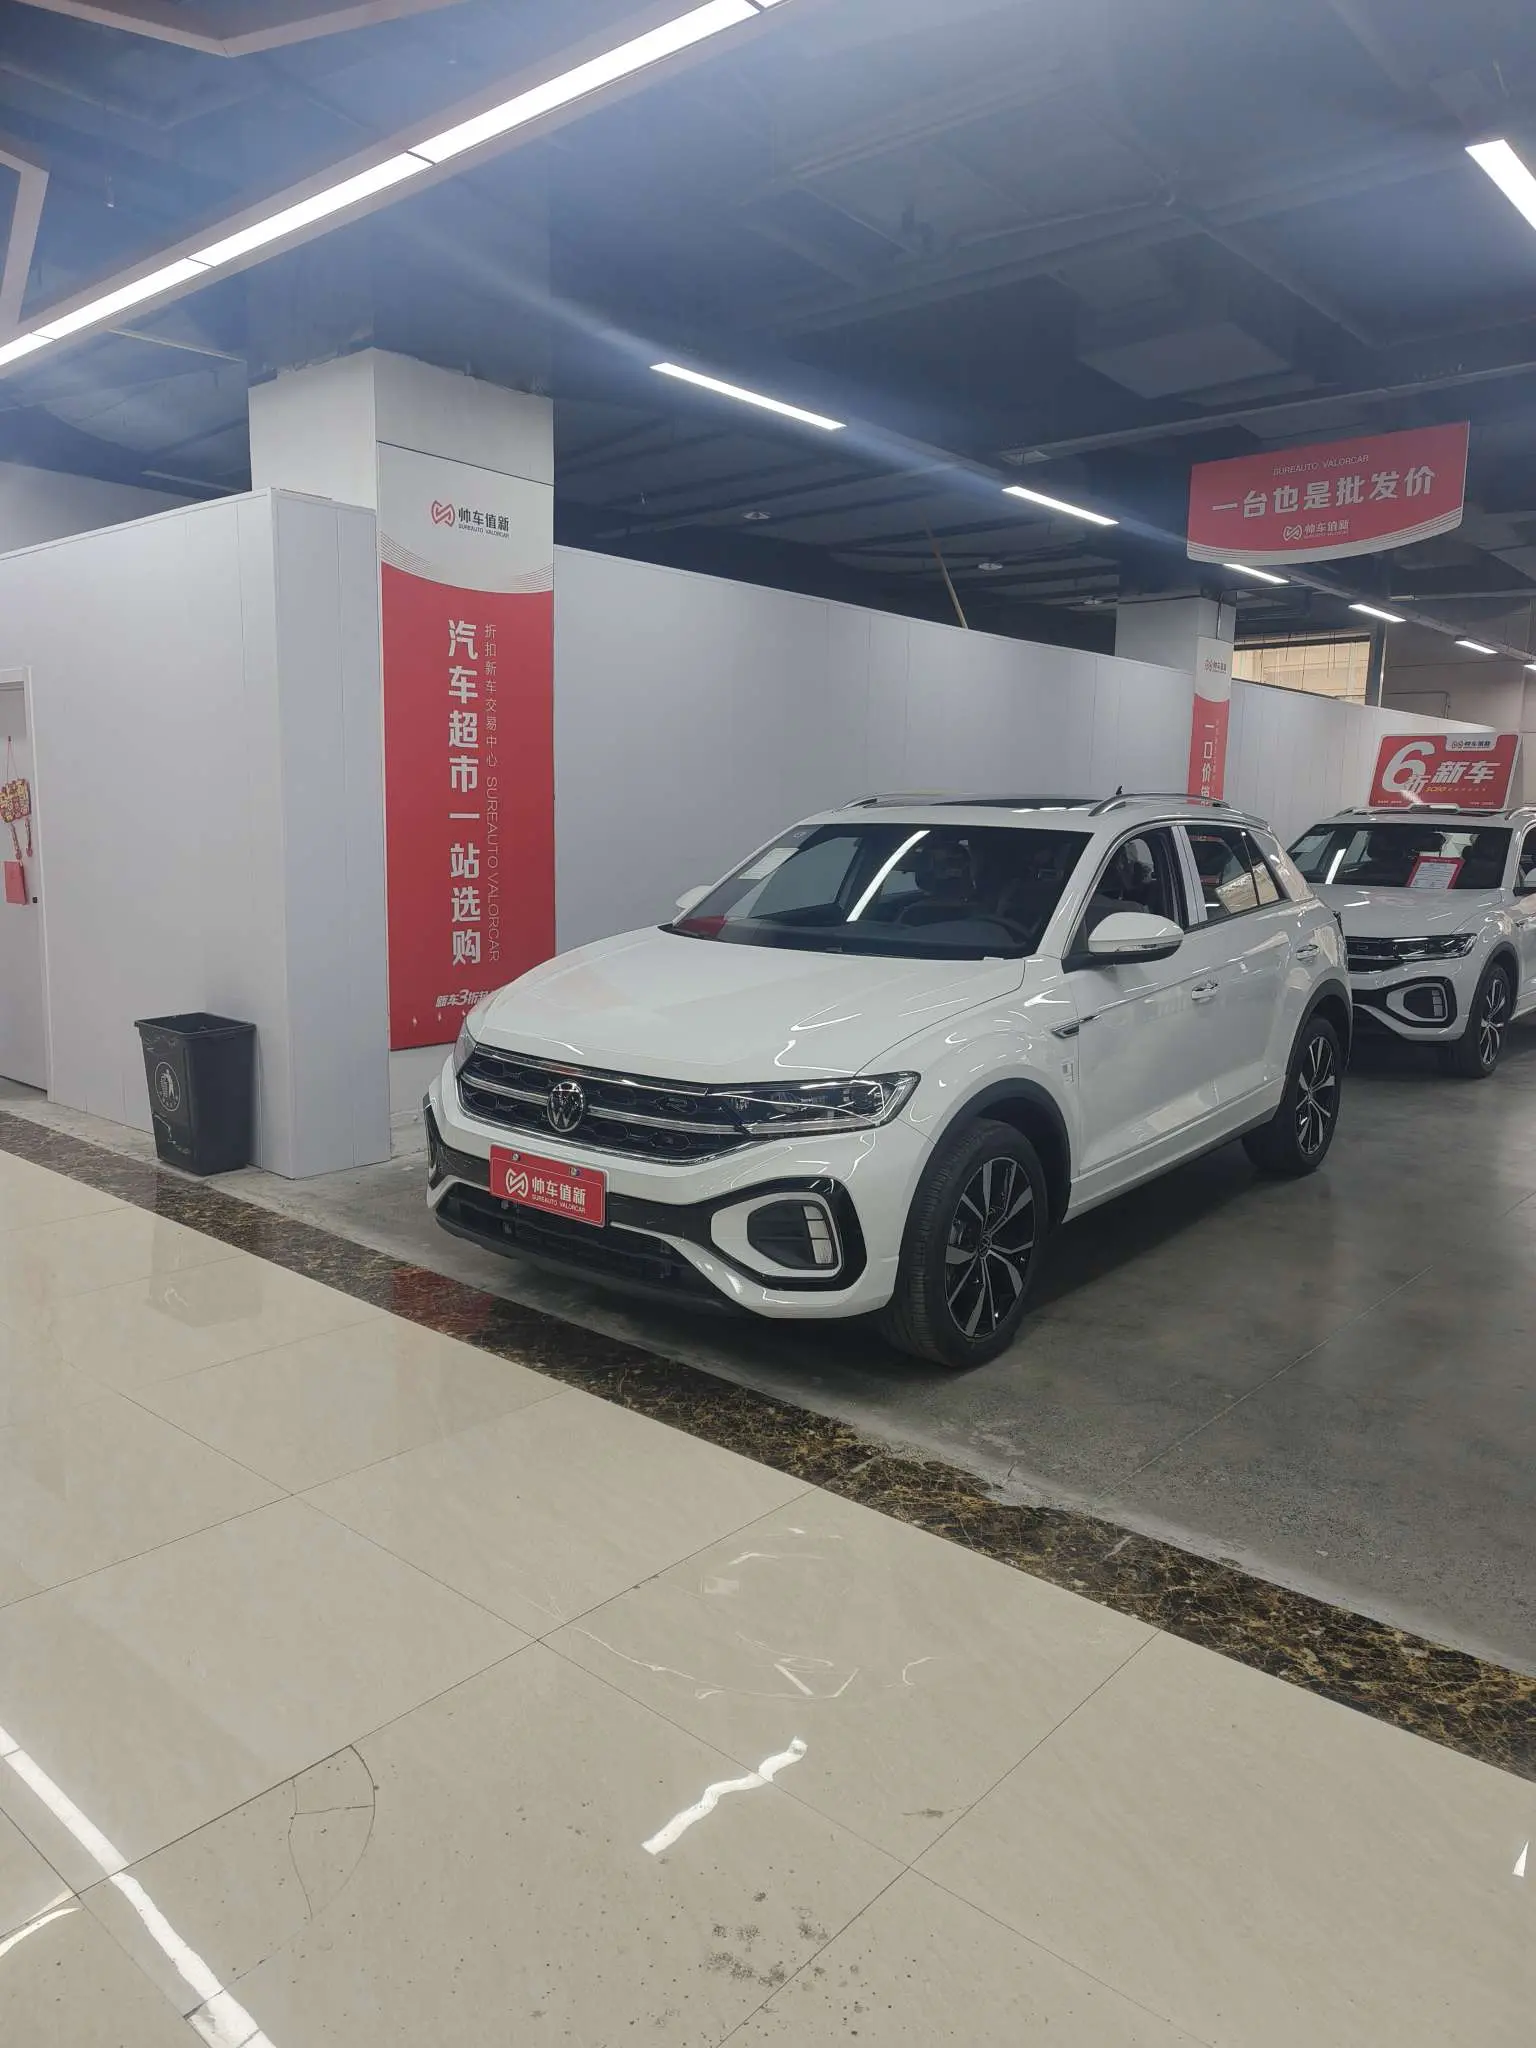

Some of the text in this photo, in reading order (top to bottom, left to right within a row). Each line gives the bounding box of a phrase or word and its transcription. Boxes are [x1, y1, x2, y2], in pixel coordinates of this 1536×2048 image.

[1211, 465, 1436, 519] 一台也是批发价
[458, 507, 509, 532] 帅车值新
[448, 619, 481, 966] 汽车超市一站选购
[484, 623, 500, 962] 折扣新车交易中心 SUREAUTO VALORCAR
[531, 1176, 586, 1205] 帅车值新
